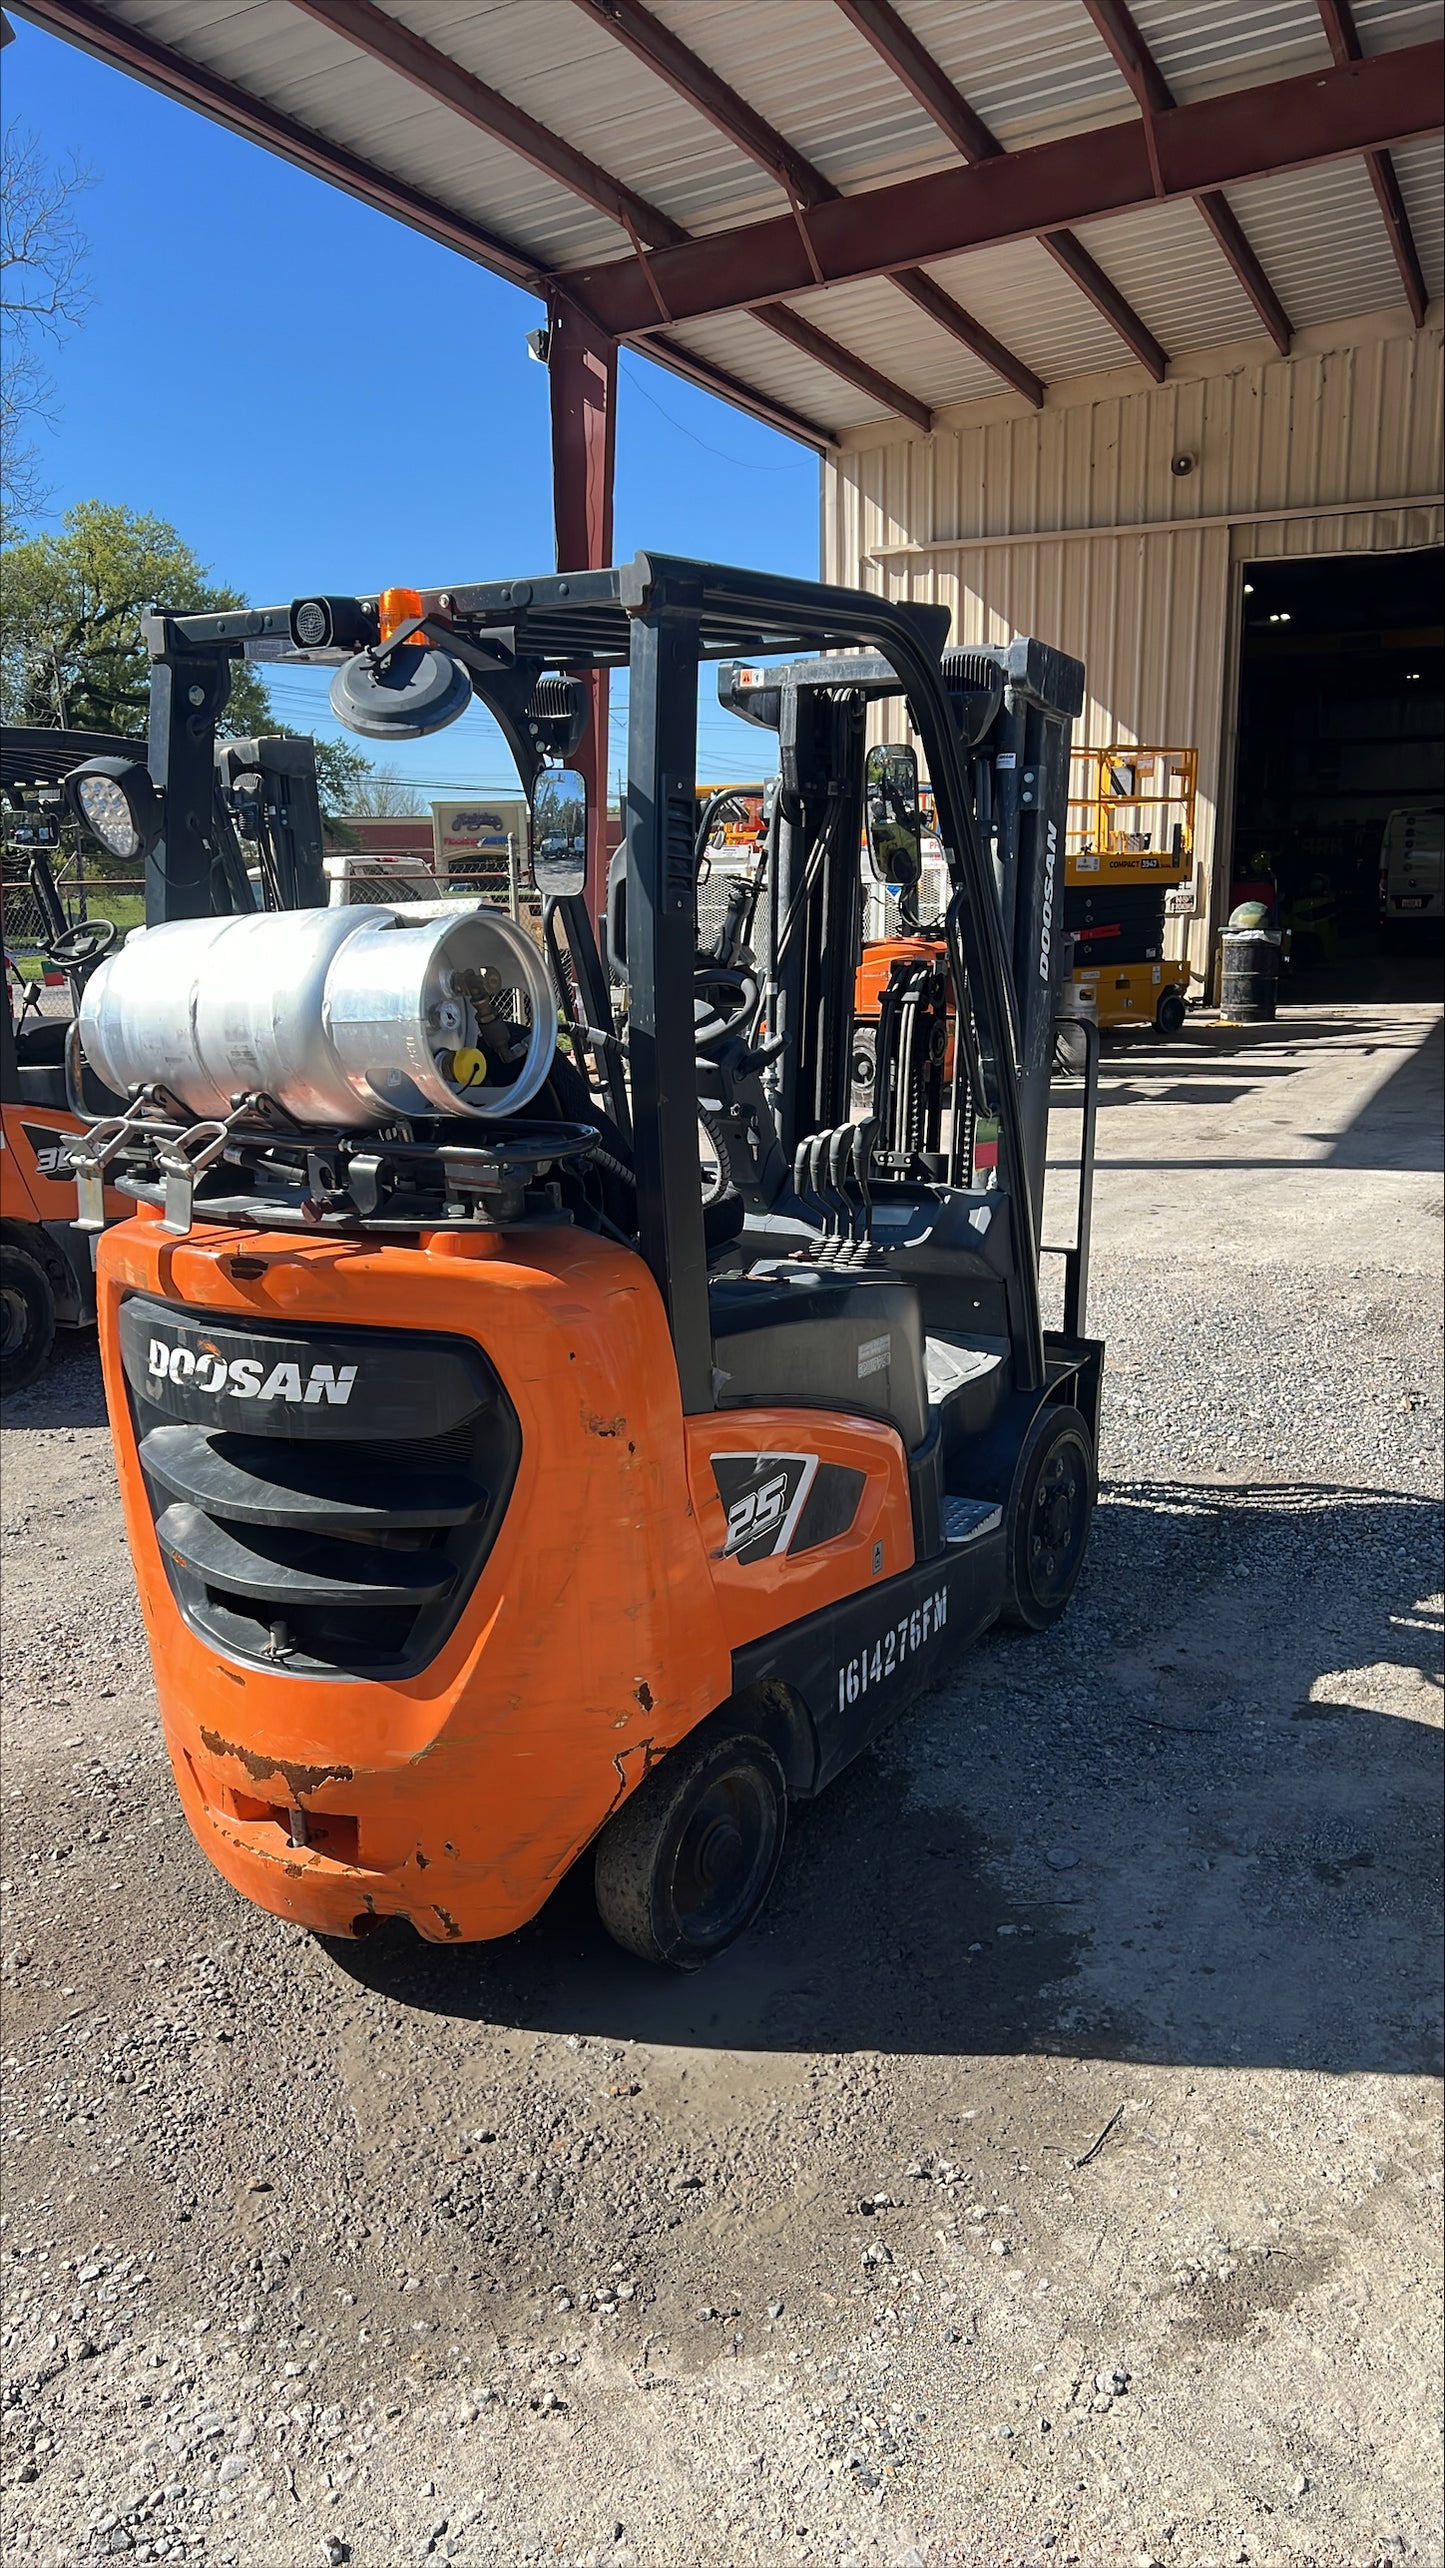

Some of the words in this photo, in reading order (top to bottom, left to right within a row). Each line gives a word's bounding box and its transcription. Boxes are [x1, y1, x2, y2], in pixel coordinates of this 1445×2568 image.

[1039, 819, 1058, 982] DOOSAN
[1109, 860, 1140, 869] COMPACT
[149, 1338, 359, 1405] DOOSAN
[723, 1473, 788, 1559] 25
[838, 1585, 948, 1713] 1614276FM
